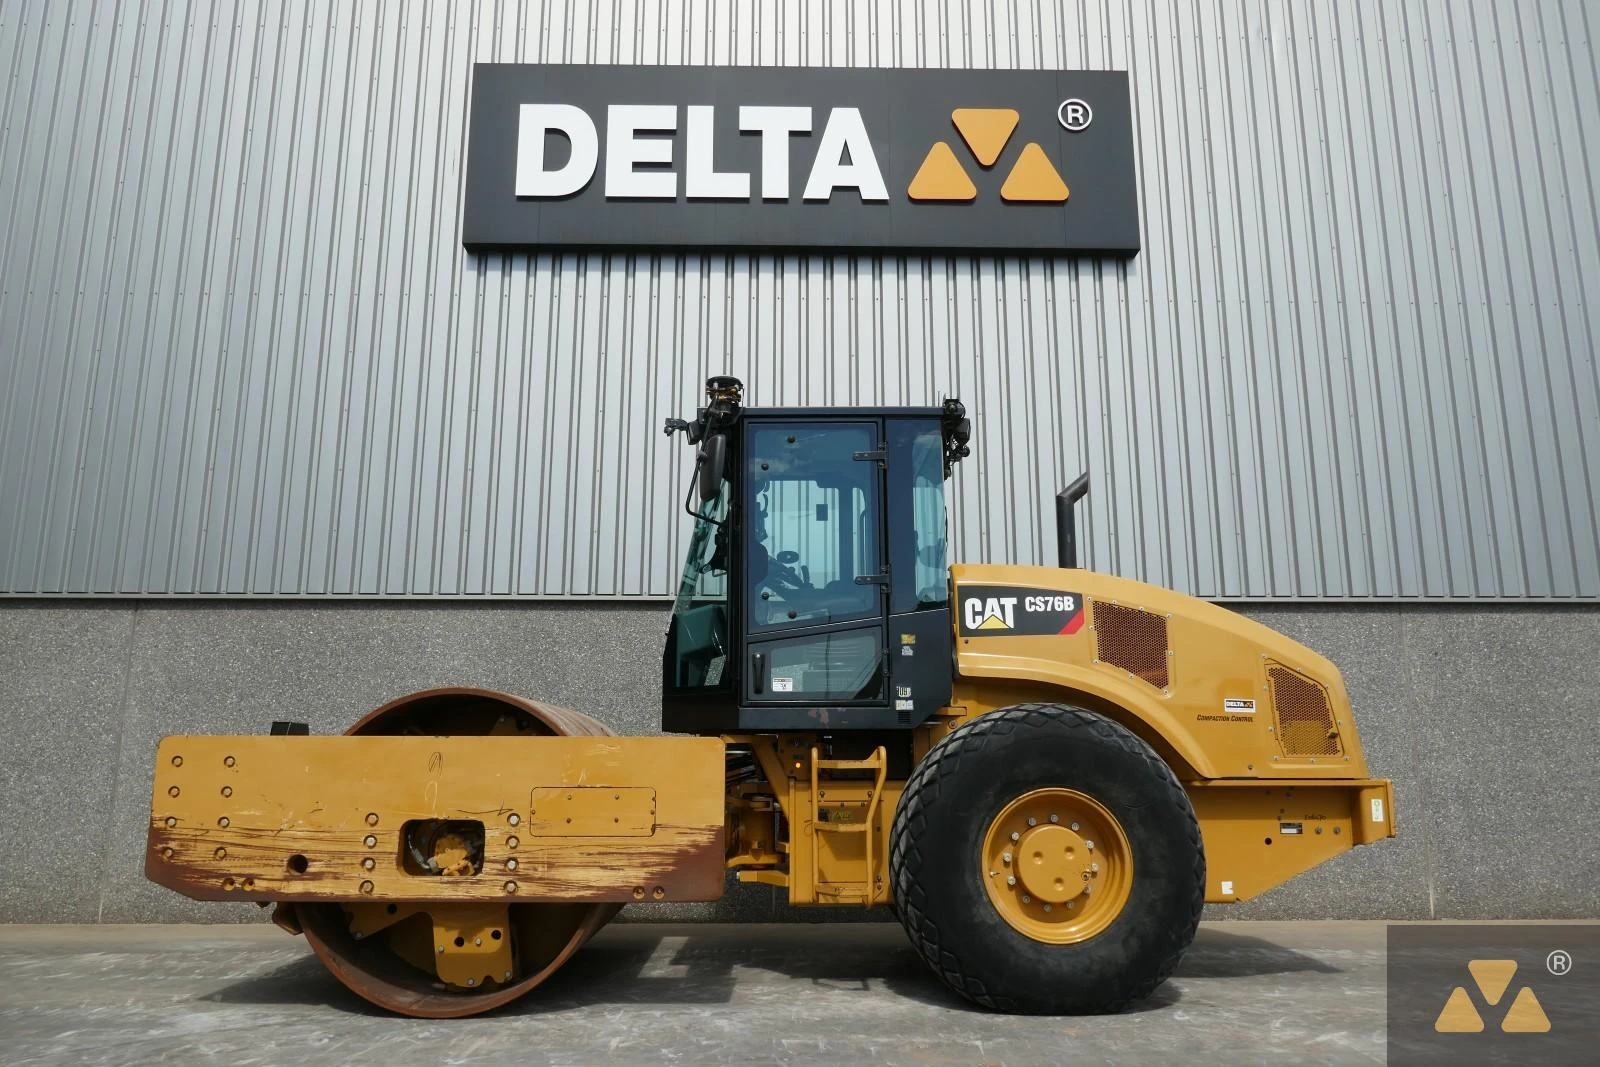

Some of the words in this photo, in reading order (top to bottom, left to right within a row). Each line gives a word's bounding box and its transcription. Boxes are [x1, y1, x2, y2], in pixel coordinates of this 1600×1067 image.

[515, 103, 889, 200] DELTA
[964, 597, 1017, 630] CAT
[1024, 595, 1075, 612] CS76B
